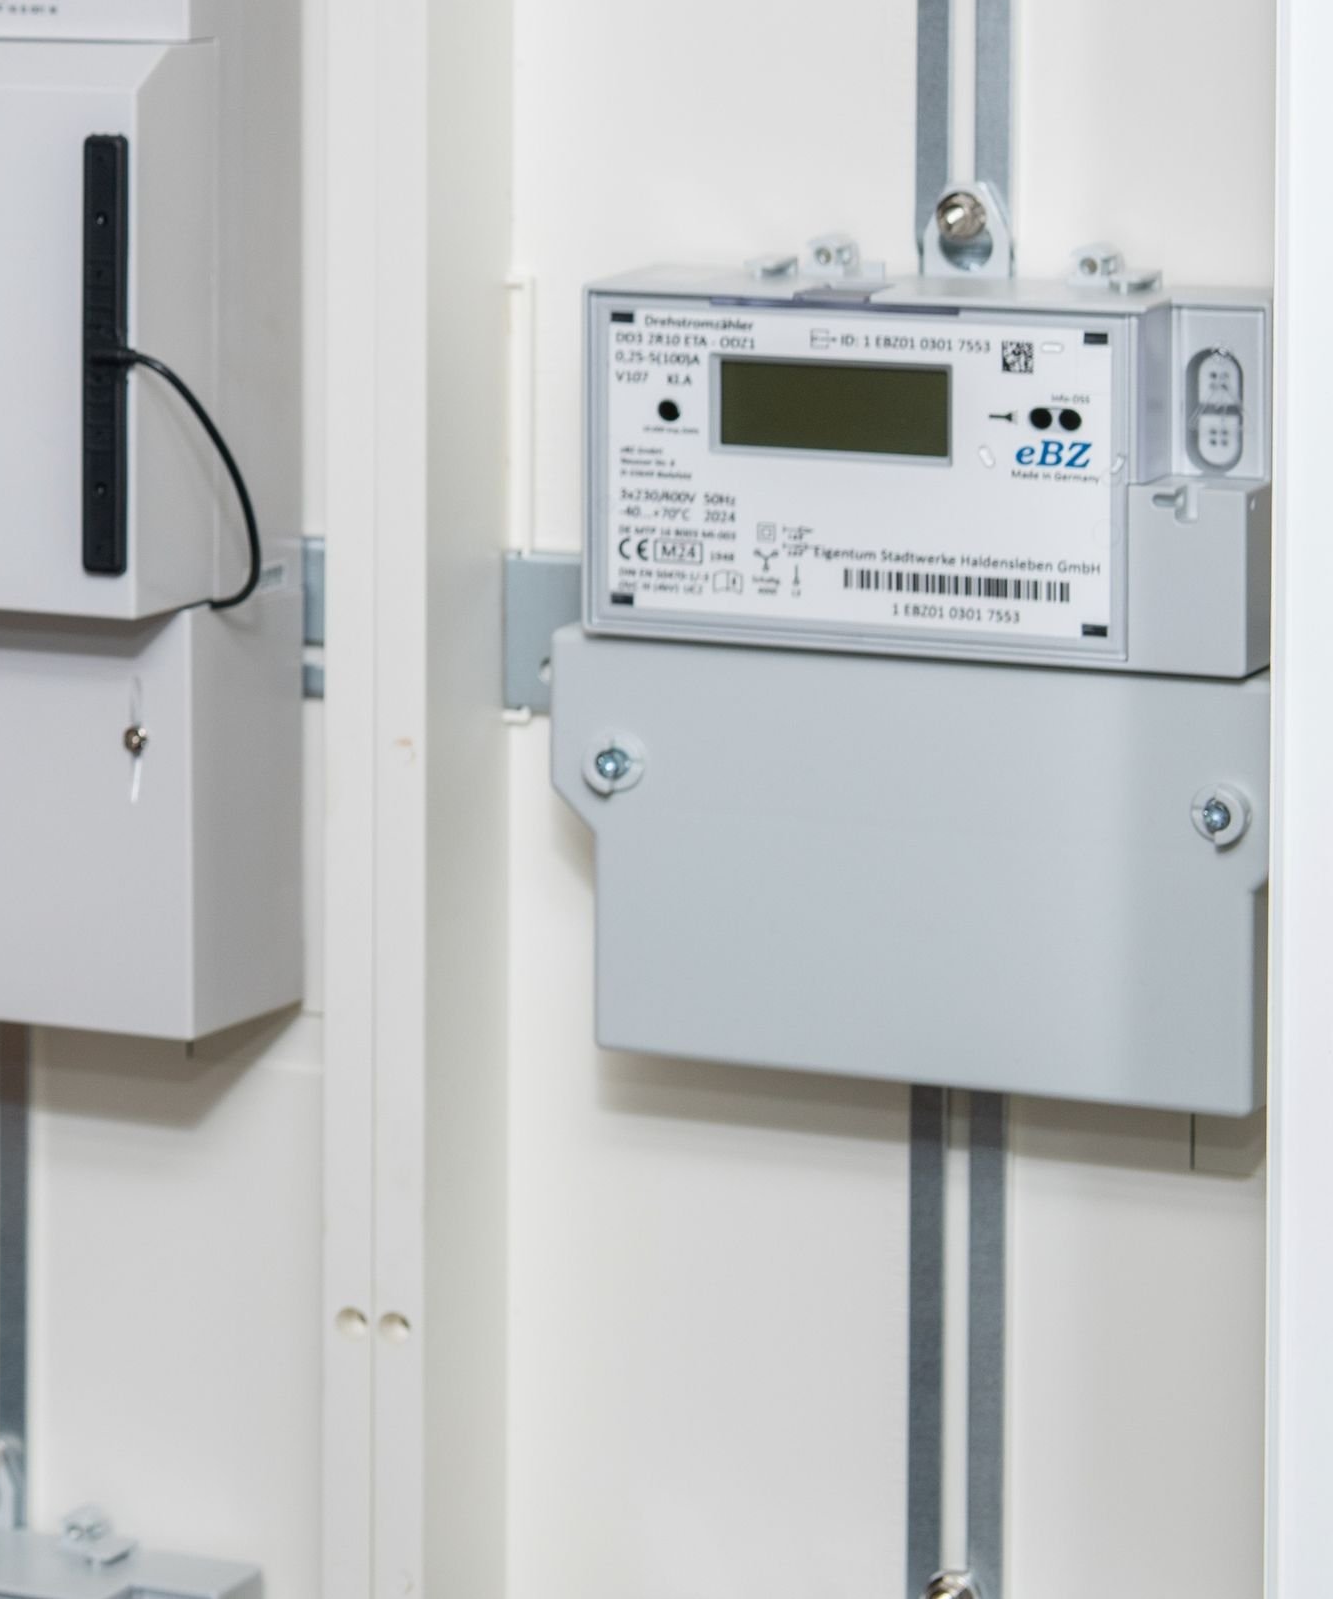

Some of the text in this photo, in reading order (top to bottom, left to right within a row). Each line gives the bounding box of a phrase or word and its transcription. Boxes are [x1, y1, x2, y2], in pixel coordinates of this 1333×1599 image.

[644, 314, 754, 332] Drehstromzähler
[684, 335, 708, 348] ETA
[840, 334, 859, 347] ID:
[920, 338, 953, 351] 0301
[958, 340, 991, 353] 7553
[615, 371, 649, 384] V107
[1015, 440, 1092, 469] eBZ
[1011, 469, 1100, 485] Made in Germany
[704, 492, 736, 506] 50Hz
[704, 510, 736, 523] 2024
[662, 545, 695, 559] M24
[814, 544, 876, 564] Eigentum
[880, 547, 956, 566] Stadtwerke
[960, 553, 1054, 572] Haldensleben
[1058, 560, 1102, 575] GmbH
[949, 607, 982, 621] 0301
[987, 610, 1020, 624] 7553
